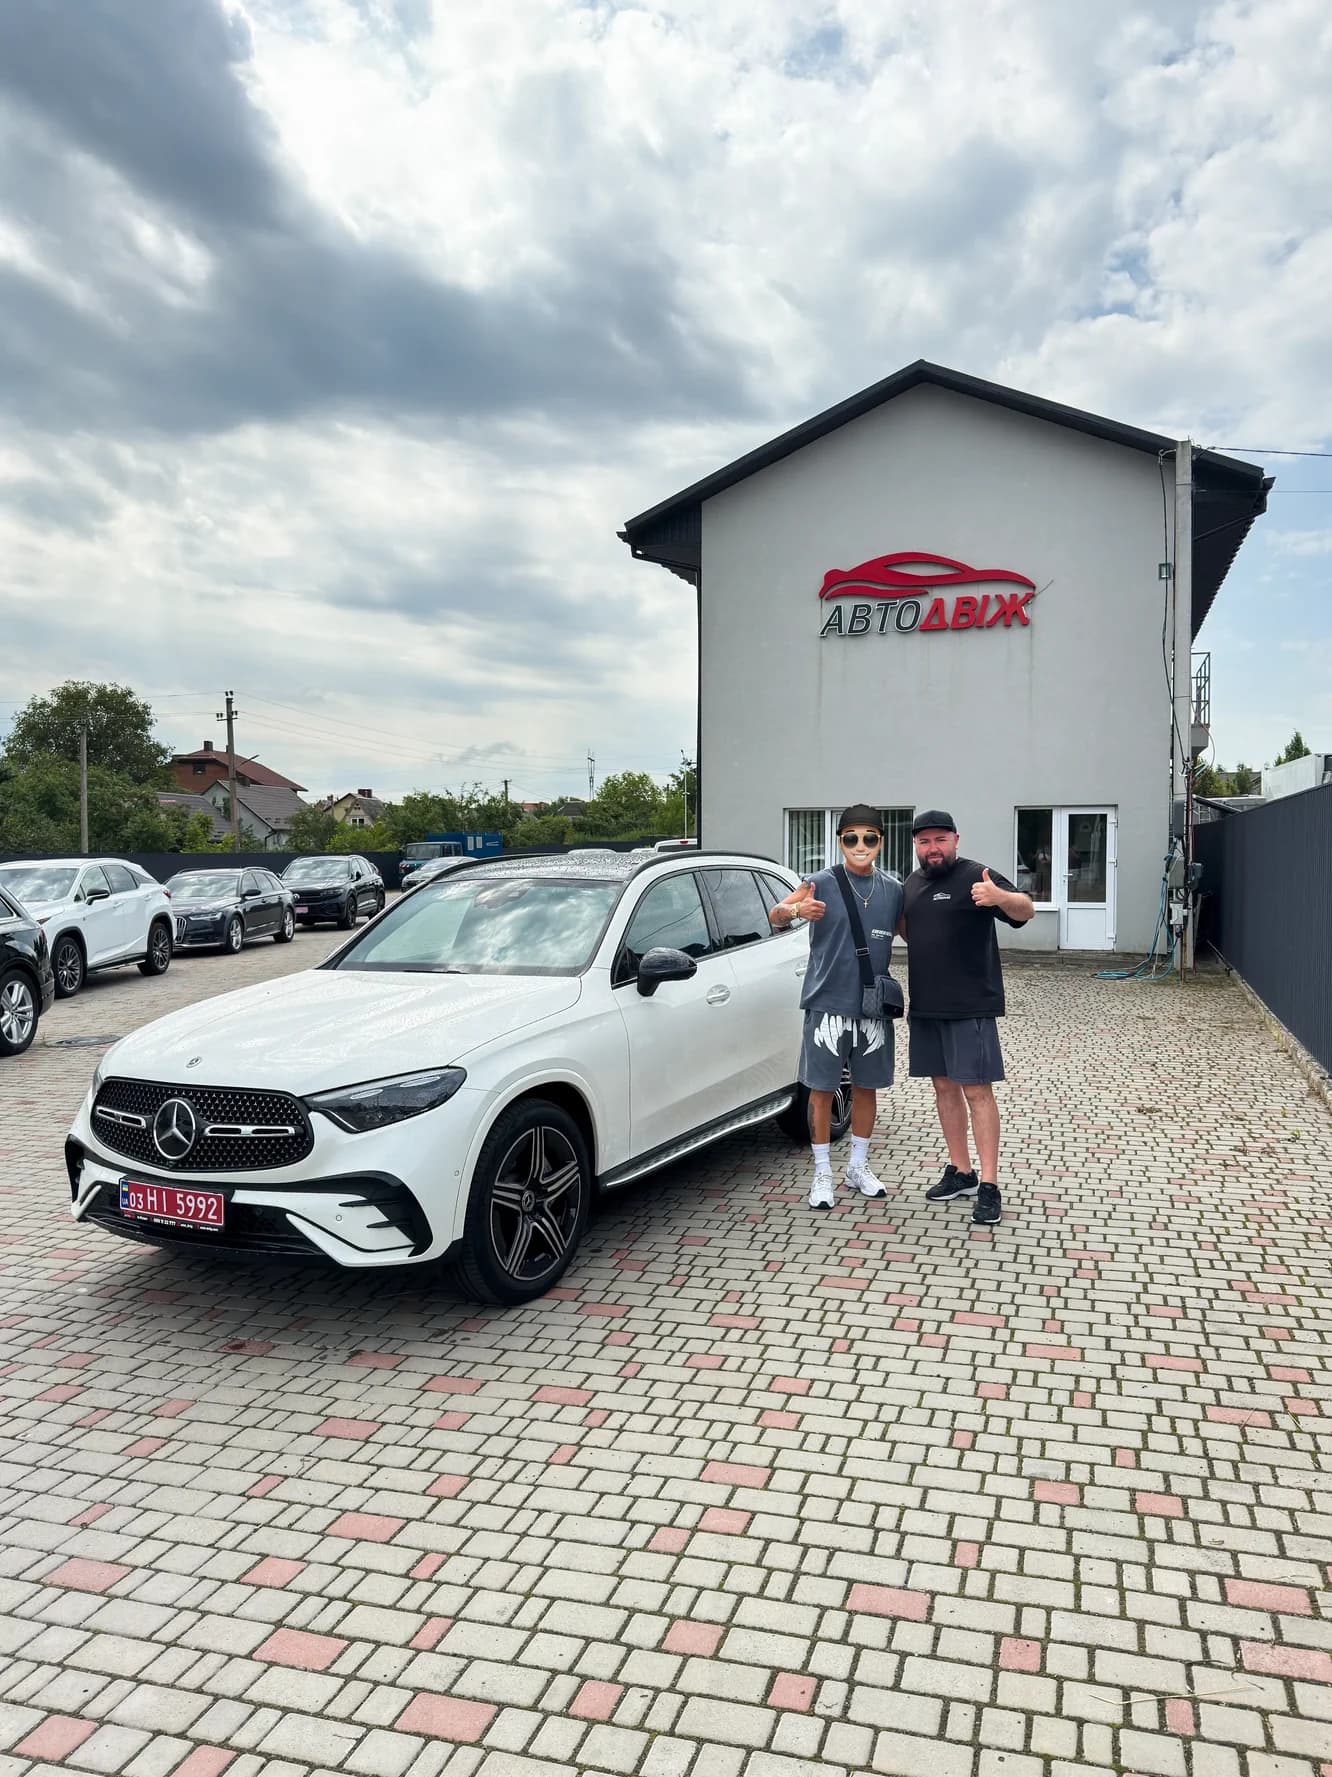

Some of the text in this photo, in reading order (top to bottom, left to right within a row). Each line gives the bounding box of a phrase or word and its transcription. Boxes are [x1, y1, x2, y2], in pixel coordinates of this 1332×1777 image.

[819, 593, 1035, 637] АВТОДВІЖ
[129, 1192, 144, 1209] 03
[176, 1193, 218, 1220] 5992
